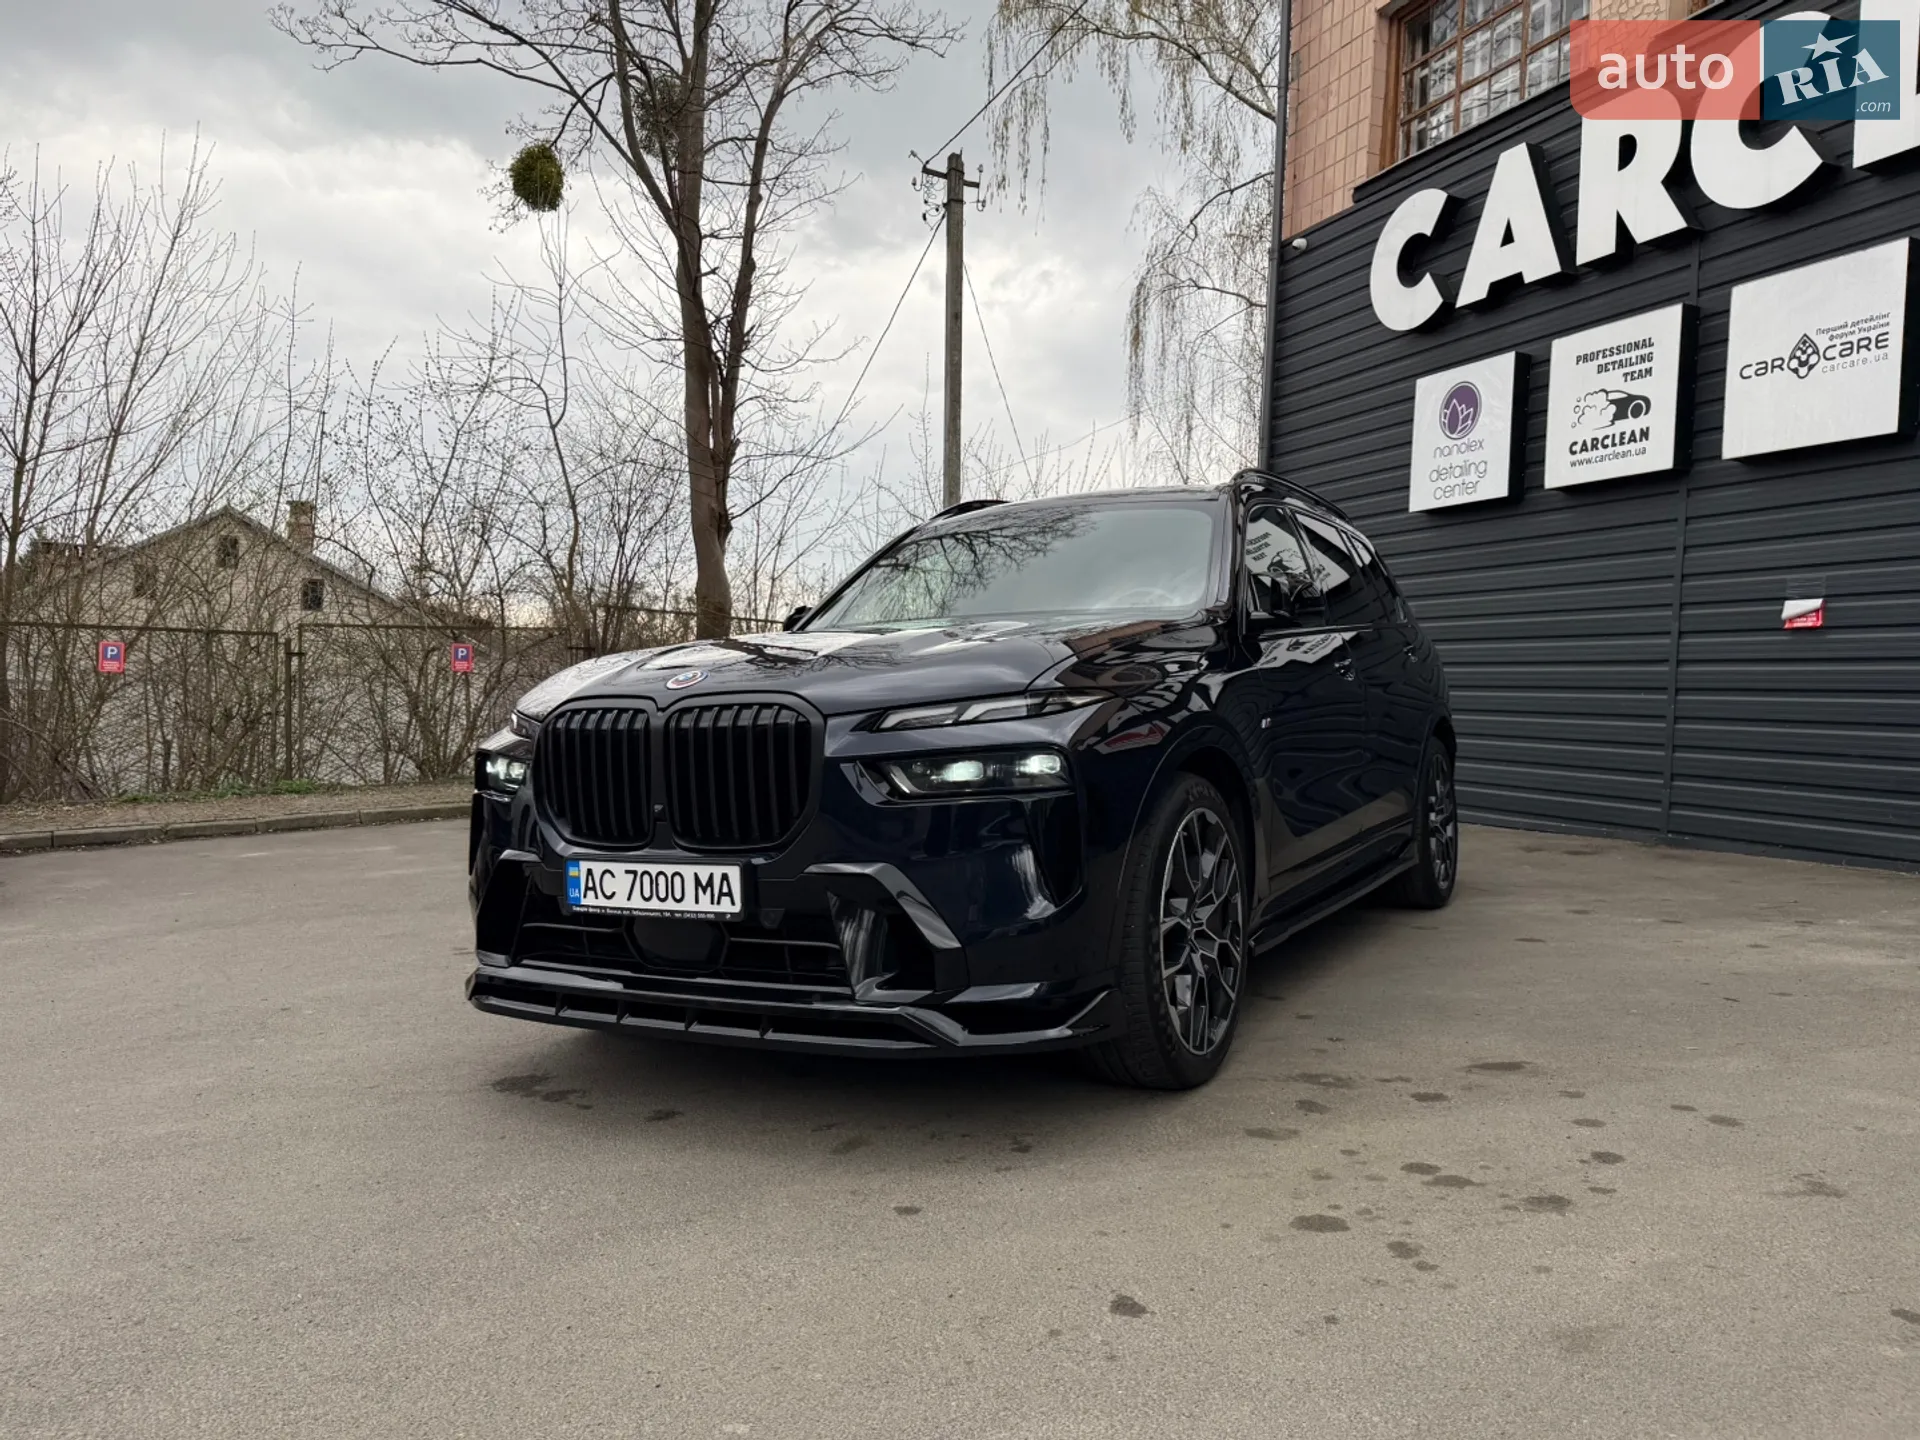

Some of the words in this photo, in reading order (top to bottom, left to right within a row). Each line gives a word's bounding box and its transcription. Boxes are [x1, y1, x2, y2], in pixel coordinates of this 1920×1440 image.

[1815, 320, 1849, 336] Перший
[1849, 311, 1891, 329] детейлінг
[1857, 321, 1891, 335] України
[1575, 337, 1655, 366] PROFESSIONAL
[1821, 351, 1889, 374] carcare.ua
[1596, 351, 1654, 375] DETAILING
[1622, 366, 1653, 383] TEAM
[1433, 437, 1485, 459] nanolex
[1568, 426, 1651, 456] CARCLEAN
[1569, 446, 1647, 468] www.carclean.ua
[1429, 459, 1488, 483] detailing
[1433, 479, 1480, 501] center
[106, 645, 119, 659] P
[457, 646, 468, 660] P
[569, 887, 580, 899] UA
[583, 868, 617, 900] AC
[624, 869, 686, 904] 7000
[693, 871, 736, 907] MA
